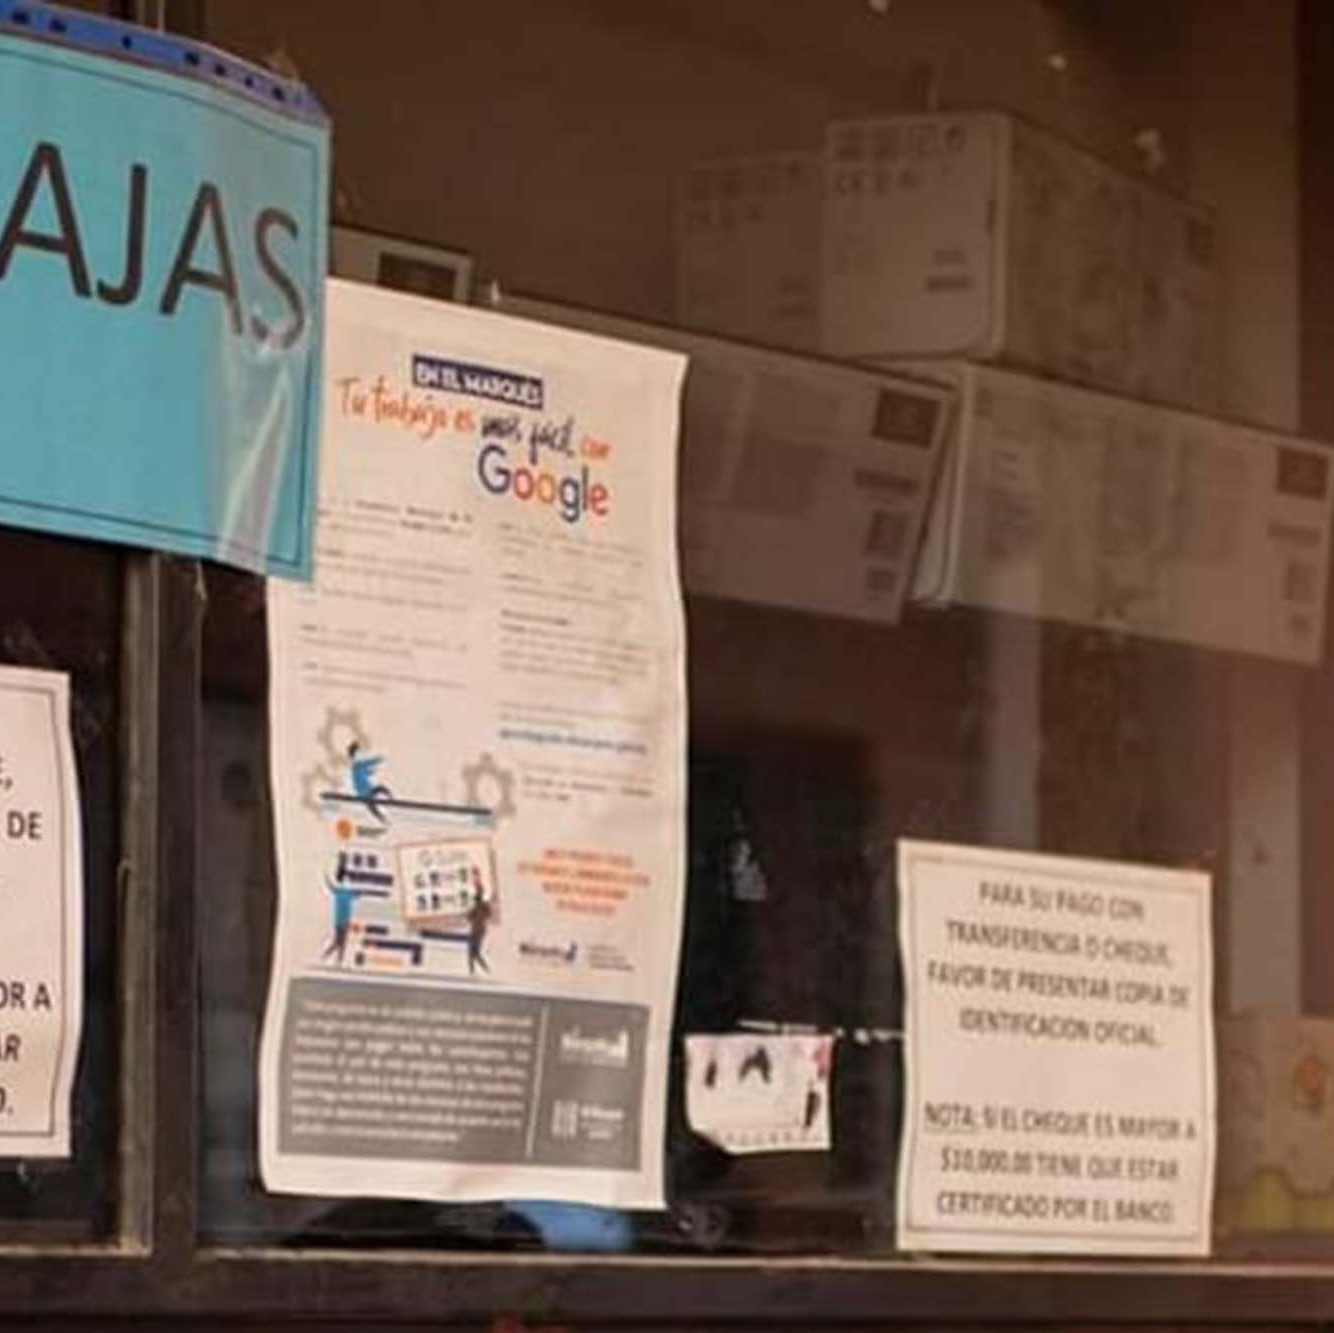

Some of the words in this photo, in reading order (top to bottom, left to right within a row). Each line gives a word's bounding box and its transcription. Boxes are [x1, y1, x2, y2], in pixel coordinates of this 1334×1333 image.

[338, 377, 364, 415] Tu
[479, 444, 609, 523] Google
[8, 811, 43, 841] DE
[979, 881, 1025, 907] PARA
[1029, 886, 1052, 911] SU
[1057, 890, 1103, 915] PAGO
[1109, 896, 1145, 920] CON
[946, 919, 1080, 955] TRANSFERENCIA
[1086, 935, 1099, 958] O
[33, 982, 52, 1010] A
[927, 960, 985, 989] FAVOR
[991, 966, 1013, 992] DE
[1018, 970, 1109, 1000] PRESENTAR
[1116, 981, 1163, 1004] COPIA
[1169, 986, 1190, 1008] DE
[960, 1007, 1089, 1041] IDENTIFICACION
[1001, 1107, 1017, 1132] EL
[1021, 1107, 1090, 1137] CHEQUE
[1095, 1111, 1114, 1137] ES
[1119, 1115, 1180, 1140] MAYOR
[1185, 1118, 1196, 1140] A
[1036, 1152, 1081, 1177] TIENE
[1087, 1156, 1121, 1180] QUE
[1126, 1157, 1179, 1180] ESTAR
[936, 1190, 1050, 1218] CERTIFICADO
[1053, 1197, 1086, 1219] POR
[1093, 1199, 1109, 1222] EL
